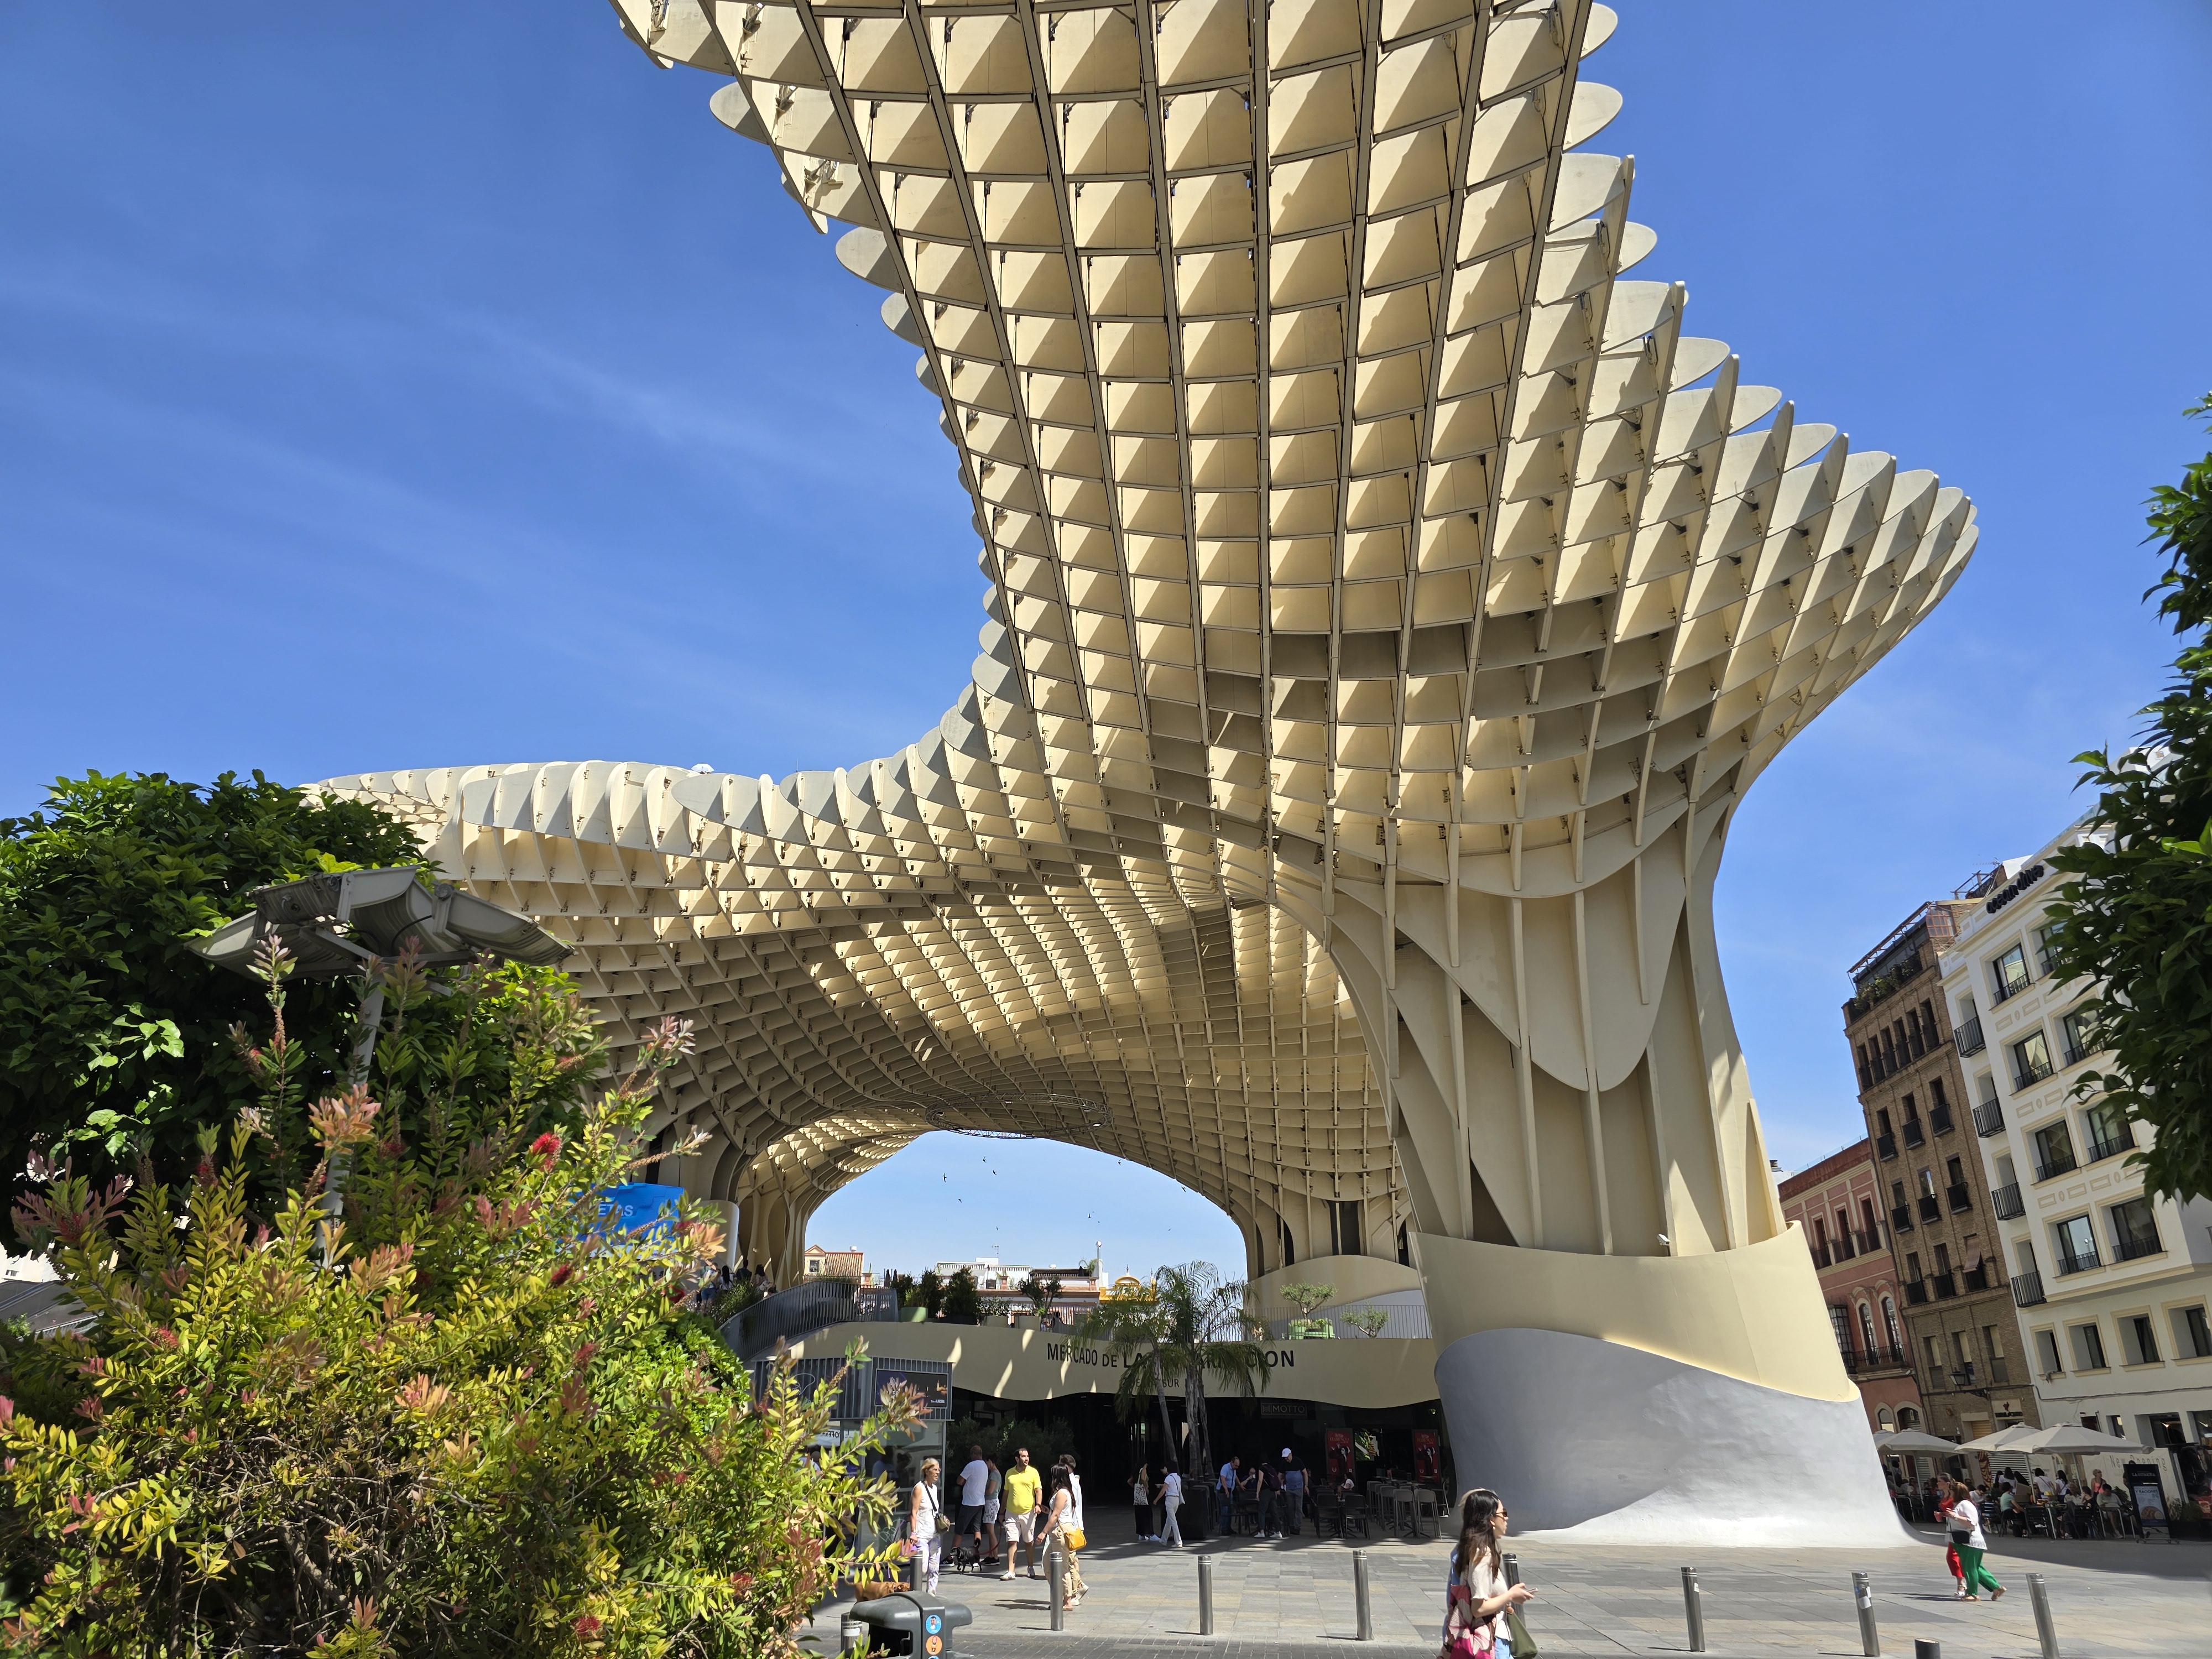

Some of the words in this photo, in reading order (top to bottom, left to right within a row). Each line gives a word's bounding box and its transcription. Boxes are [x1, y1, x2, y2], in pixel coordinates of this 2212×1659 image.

[1986, 885, 2019, 914] ocean
[2016, 865, 2044, 890] drive
[598, 1203, 633, 1217] ETAS
[1047, 1343, 1098, 1366] MERCADO
[1102, 1353, 1117, 1368] DE
